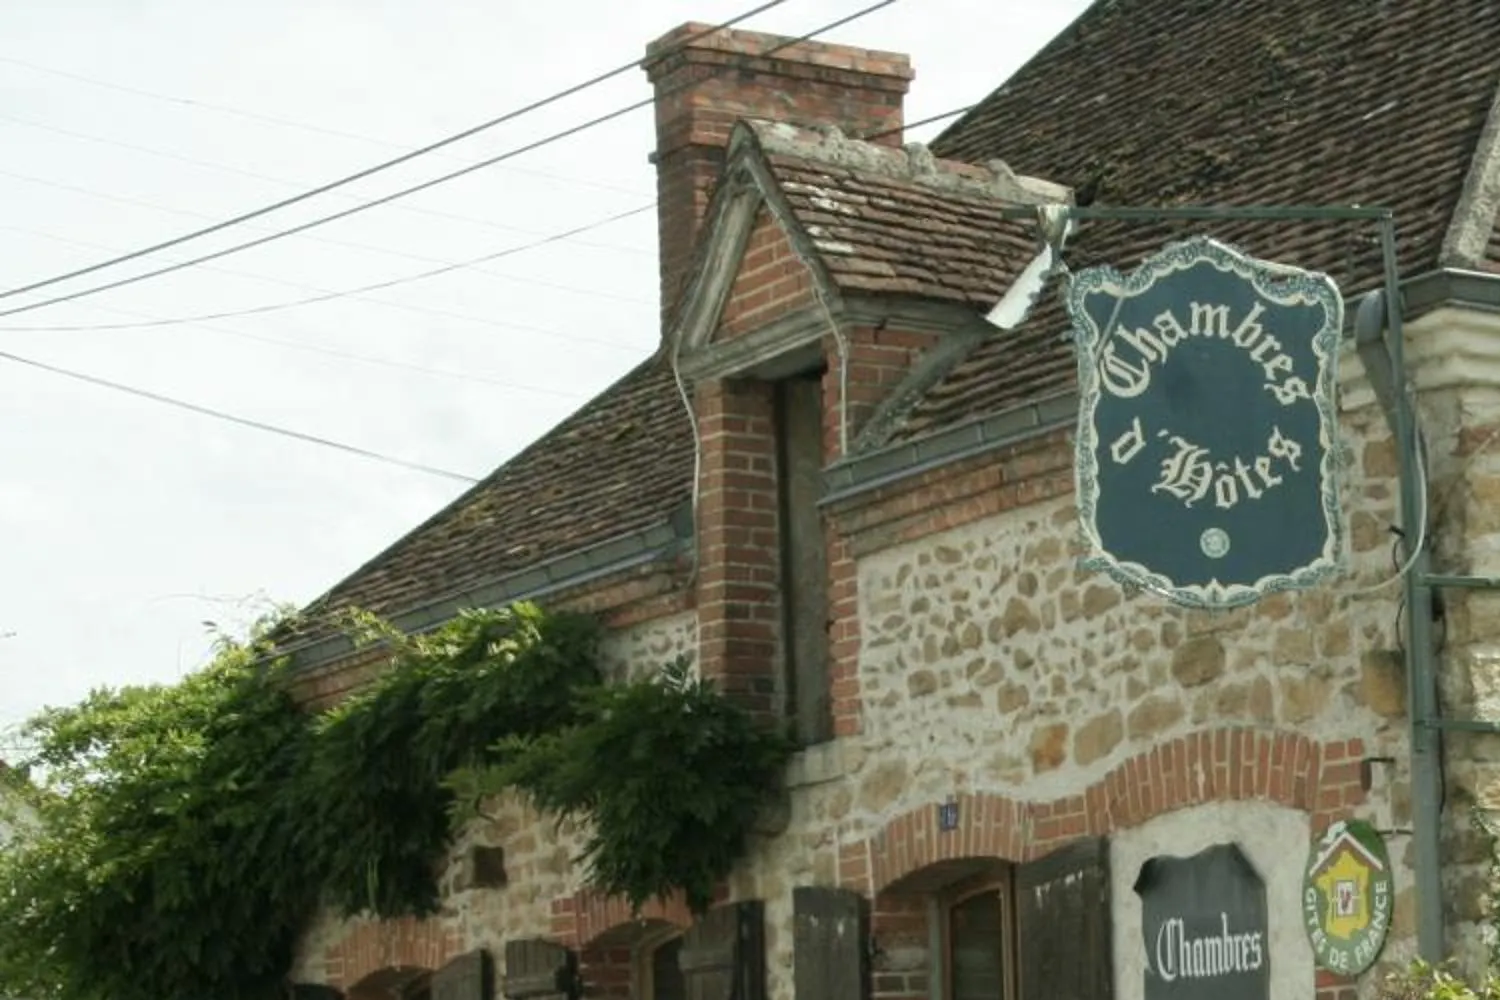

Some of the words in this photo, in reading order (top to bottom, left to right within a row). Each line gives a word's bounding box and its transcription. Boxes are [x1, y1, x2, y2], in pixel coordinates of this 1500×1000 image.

[1100, 301, 1313, 405] Chambres
[1157, 911, 1263, 982] Chambres
[1329, 947, 1349, 970] DE
[1354, 881, 1388, 966] FRANCE
